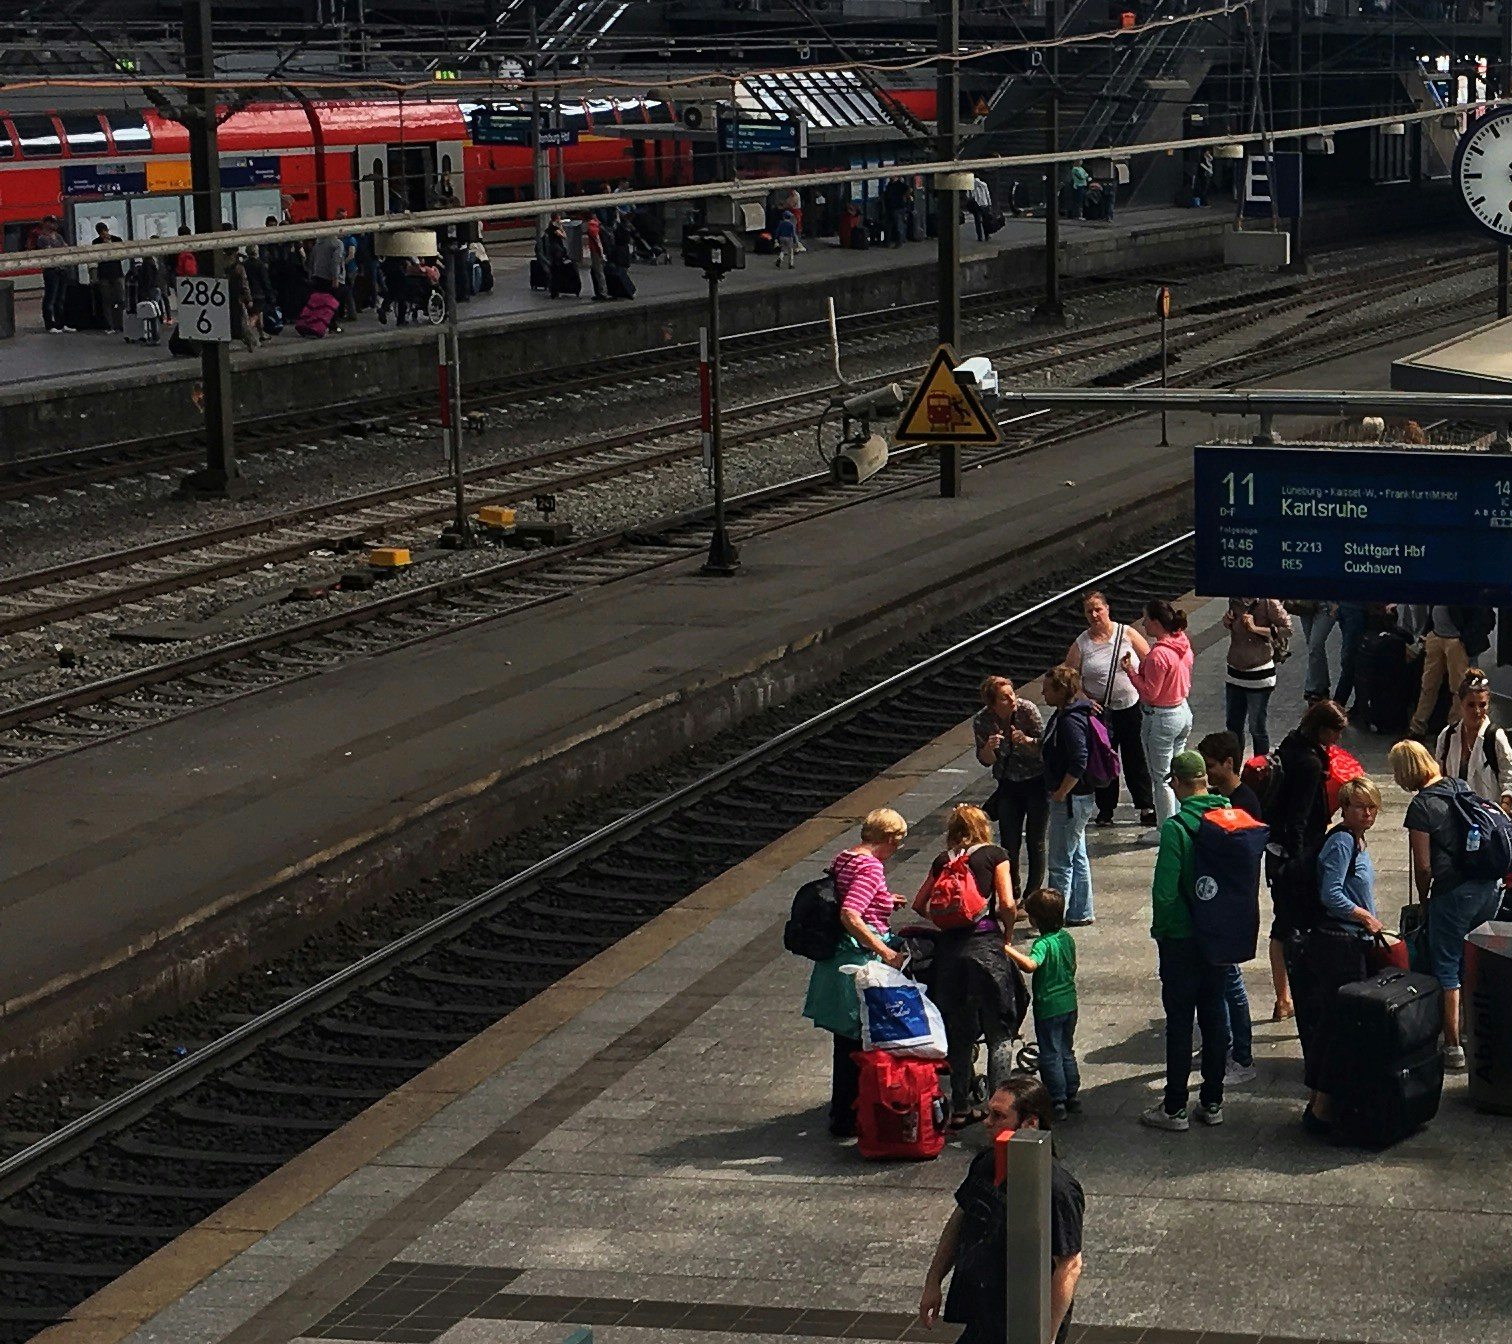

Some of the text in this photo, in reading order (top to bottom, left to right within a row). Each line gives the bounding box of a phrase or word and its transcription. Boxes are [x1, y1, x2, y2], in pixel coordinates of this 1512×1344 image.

[1245, 155, 1274, 203] E
[180, 280, 226, 306] 286
[196, 309, 212, 334] 6
[1221, 471, 1254, 506] 11
[1219, 507, 1236, 517] D-F
[1281, 498, 1368, 519] Karlsruhe
[1220, 538, 1426, 558] 14:46 IC 2213 Stuttgart Hbf
[1220, 556, 1402, 574] 15:06 RE5 Cuxhaven
[1473, 991, 1494, 1085] Abfall
